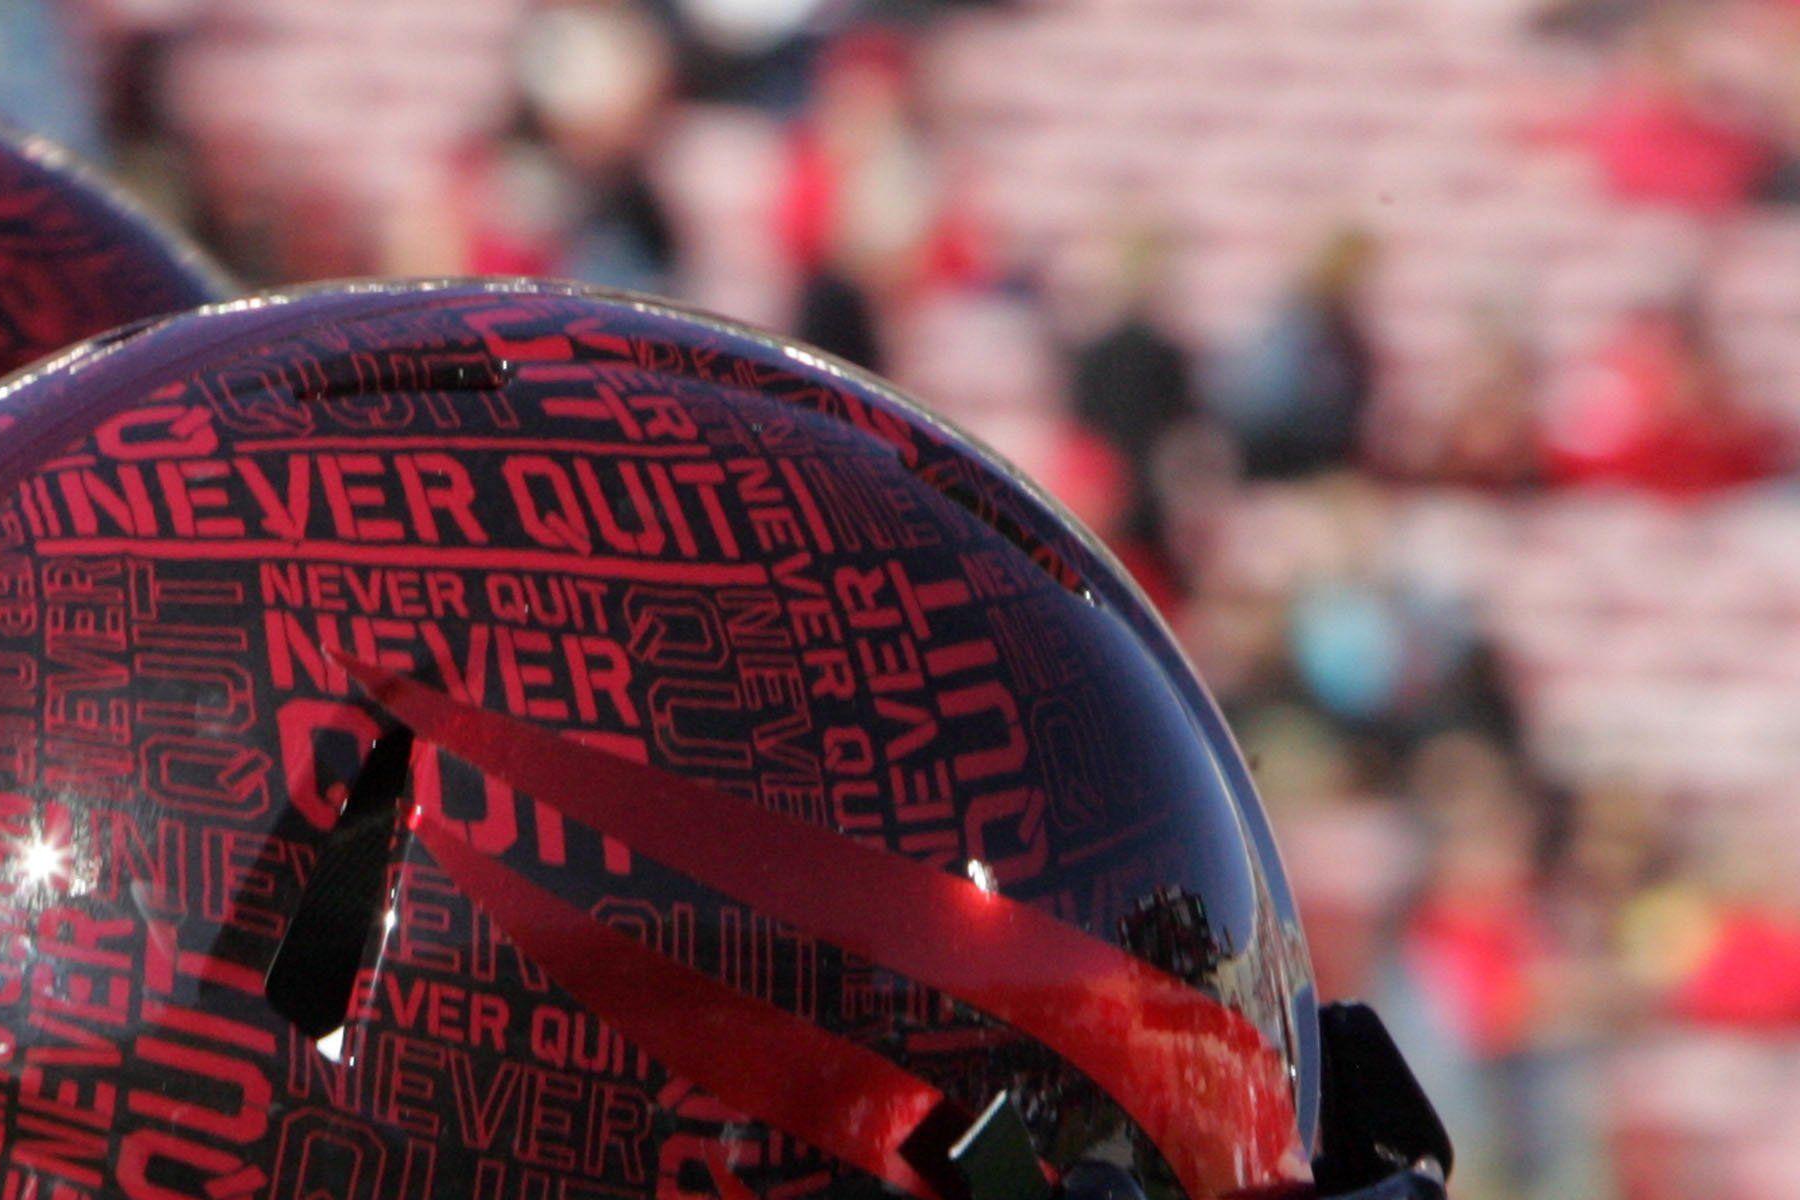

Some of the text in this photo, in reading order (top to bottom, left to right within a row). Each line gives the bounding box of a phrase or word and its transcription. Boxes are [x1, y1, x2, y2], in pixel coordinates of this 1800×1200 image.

[52, 450, 492, 547] NEVER
[502, 453, 742, 560] QUIT
[258, 560, 612, 634] NEVER QUIT
[130, 555, 276, 822] QUIT
[262, 608, 641, 728] NEVER
[620, 583, 762, 797] QU
[712, 583, 830, 828] NEVE
[822, 724, 890, 852] QU
[348, 966, 513, 1052] EVER
